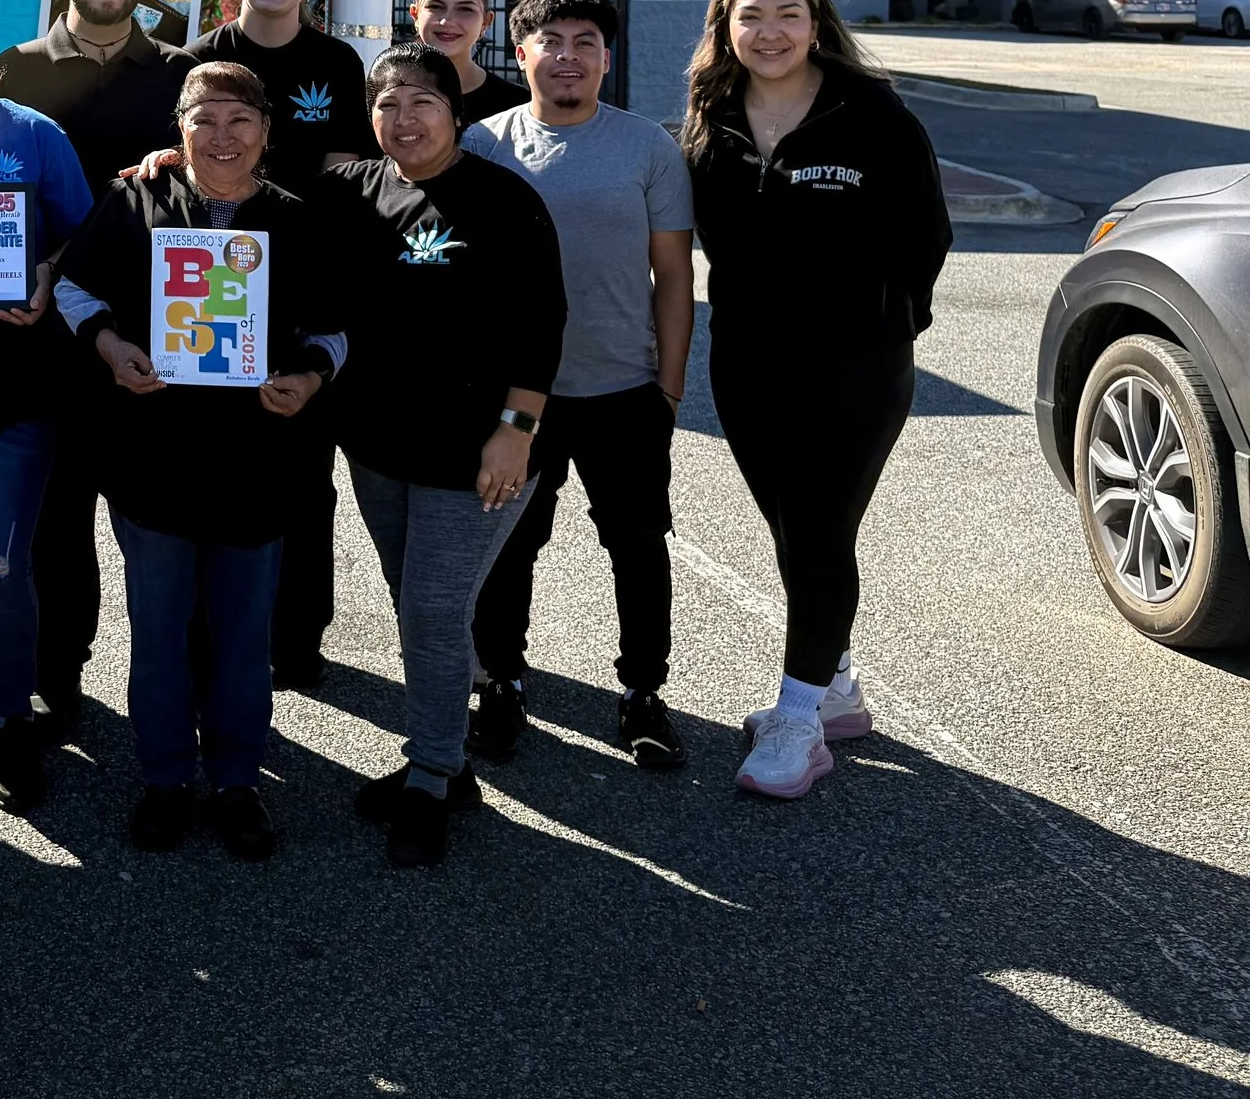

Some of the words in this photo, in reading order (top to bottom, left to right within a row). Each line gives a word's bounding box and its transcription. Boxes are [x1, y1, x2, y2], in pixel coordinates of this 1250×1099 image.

[790, 165, 863, 187] BODYROK
[157, 235, 223, 247] STATESBORO'S
[398, 250, 450, 264] AZUL
[240, 313, 256, 332] of
[242, 333, 255, 375] 2025
